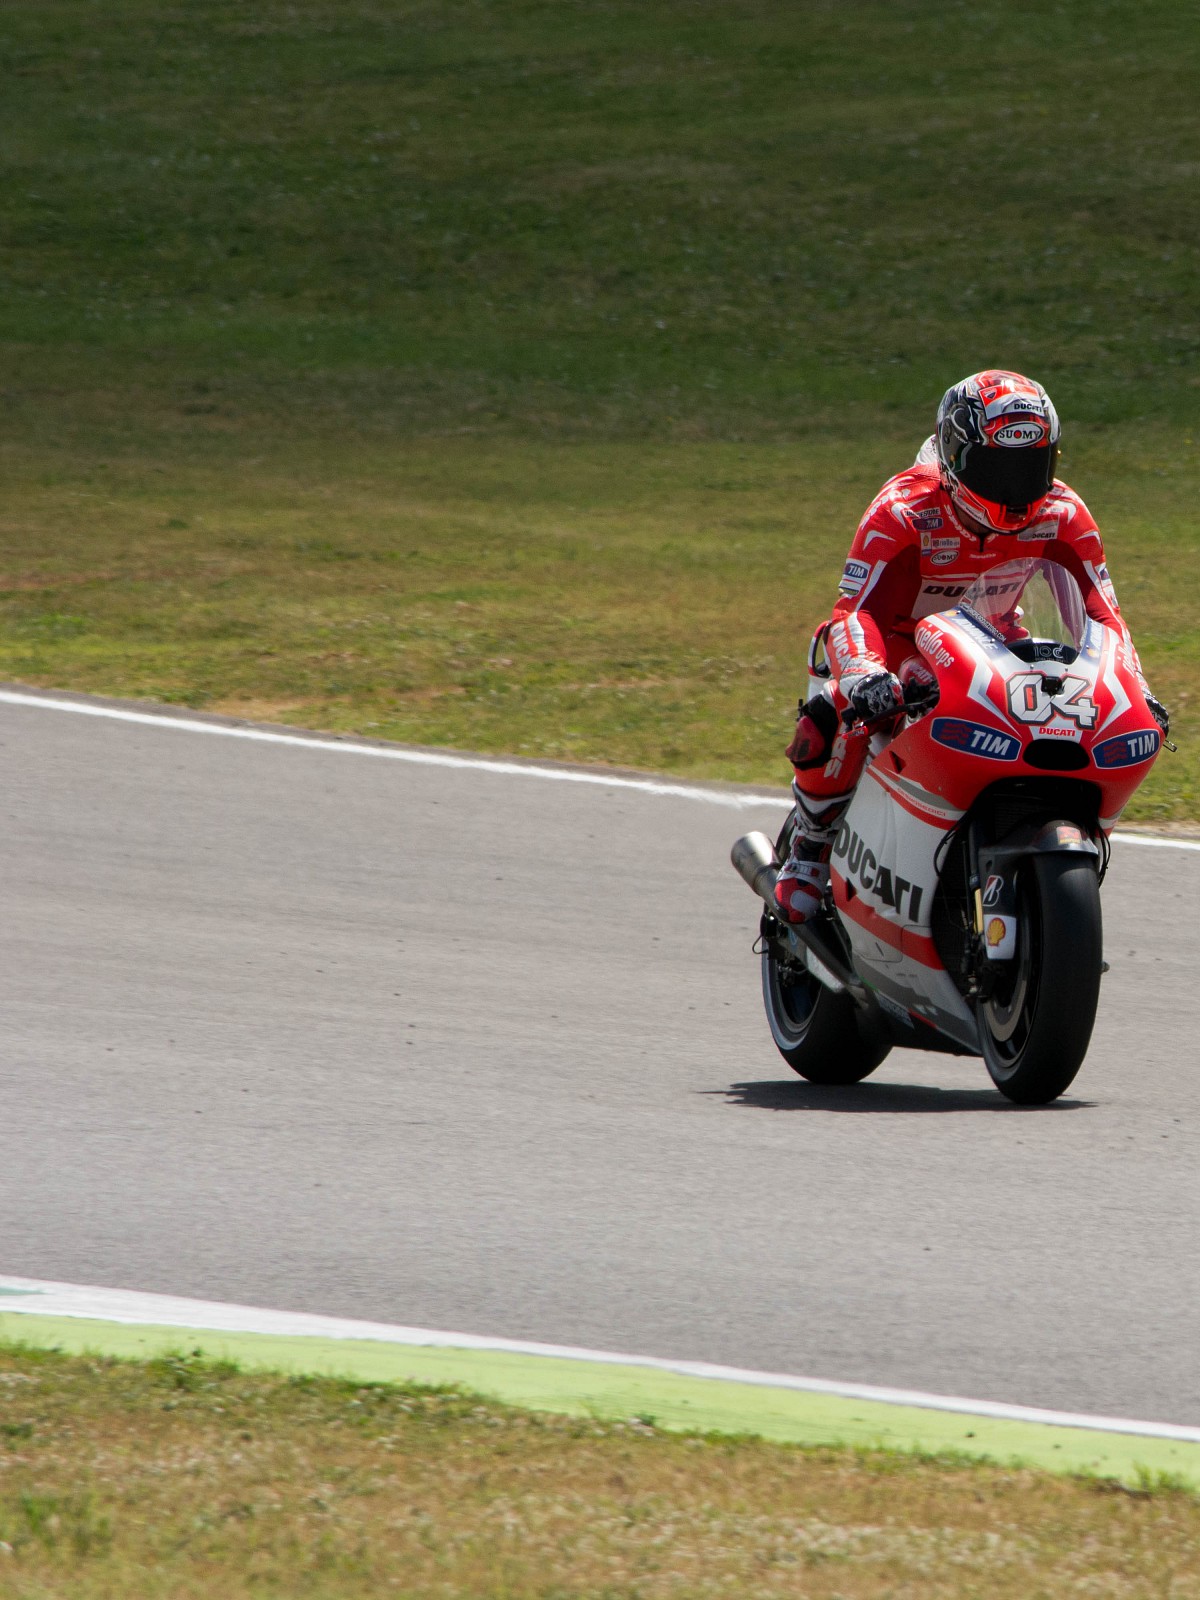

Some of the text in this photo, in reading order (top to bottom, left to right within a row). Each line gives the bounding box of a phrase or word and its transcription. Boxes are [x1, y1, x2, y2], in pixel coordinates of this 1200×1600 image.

[1014, 403, 1042, 412] DUCATI
[1000, 430, 1040, 439] SUOMY
[849, 565, 865, 577] TIM
[923, 582, 1021, 598] DUCATI
[916, 624, 955, 668] riello ups
[1005, 671, 1099, 731] 04
[1039, 727, 1076, 737] DUCATI
[970, 730, 1011, 756] TIM
[1128, 733, 1155, 758] TIM
[834, 820, 923, 923] DUCATI
